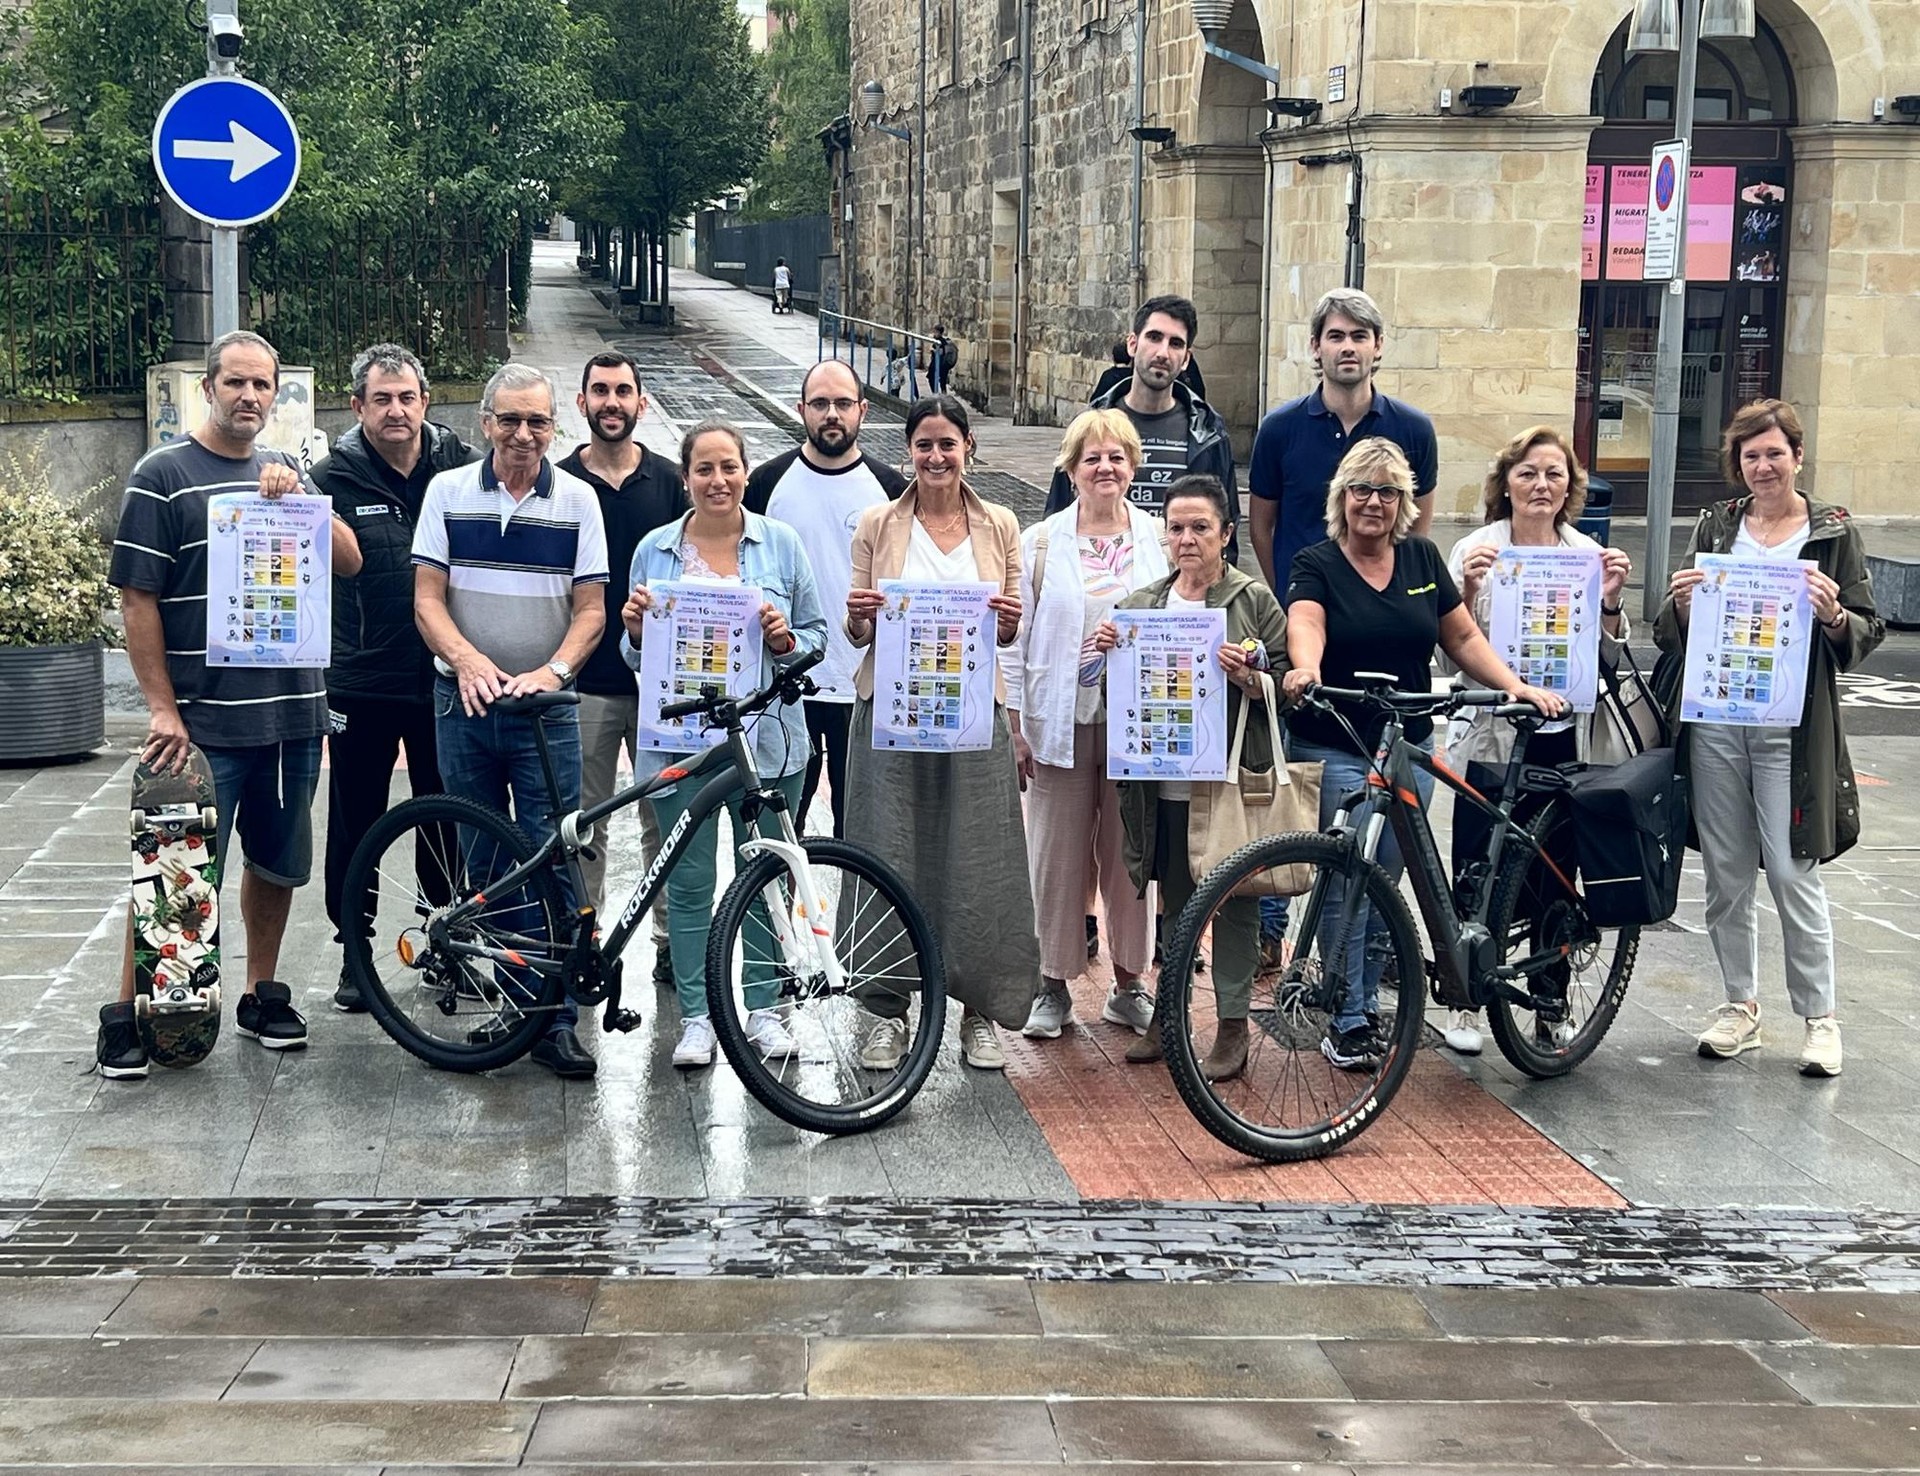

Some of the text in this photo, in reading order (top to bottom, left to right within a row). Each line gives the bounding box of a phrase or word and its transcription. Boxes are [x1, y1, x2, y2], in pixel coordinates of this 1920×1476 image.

[1585, 177, 1598, 186] 17
[1583, 215, 1596, 225] 23
[1587, 253, 1593, 262] 1
[1150, 470, 1173, 483] ez
[1130, 485, 1153, 502] da
[264, 517, 276, 527] 16
[1542, 570, 1553, 579] 16
[1749, 580, 1760, 589] 16
[698, 606, 710, 615] 16
[931, 605, 943, 615] 16
[1160, 633, 1172, 642] 16
[620, 808, 693, 930] ROCKRIDER
[196, 965, 218, 983] Atik
